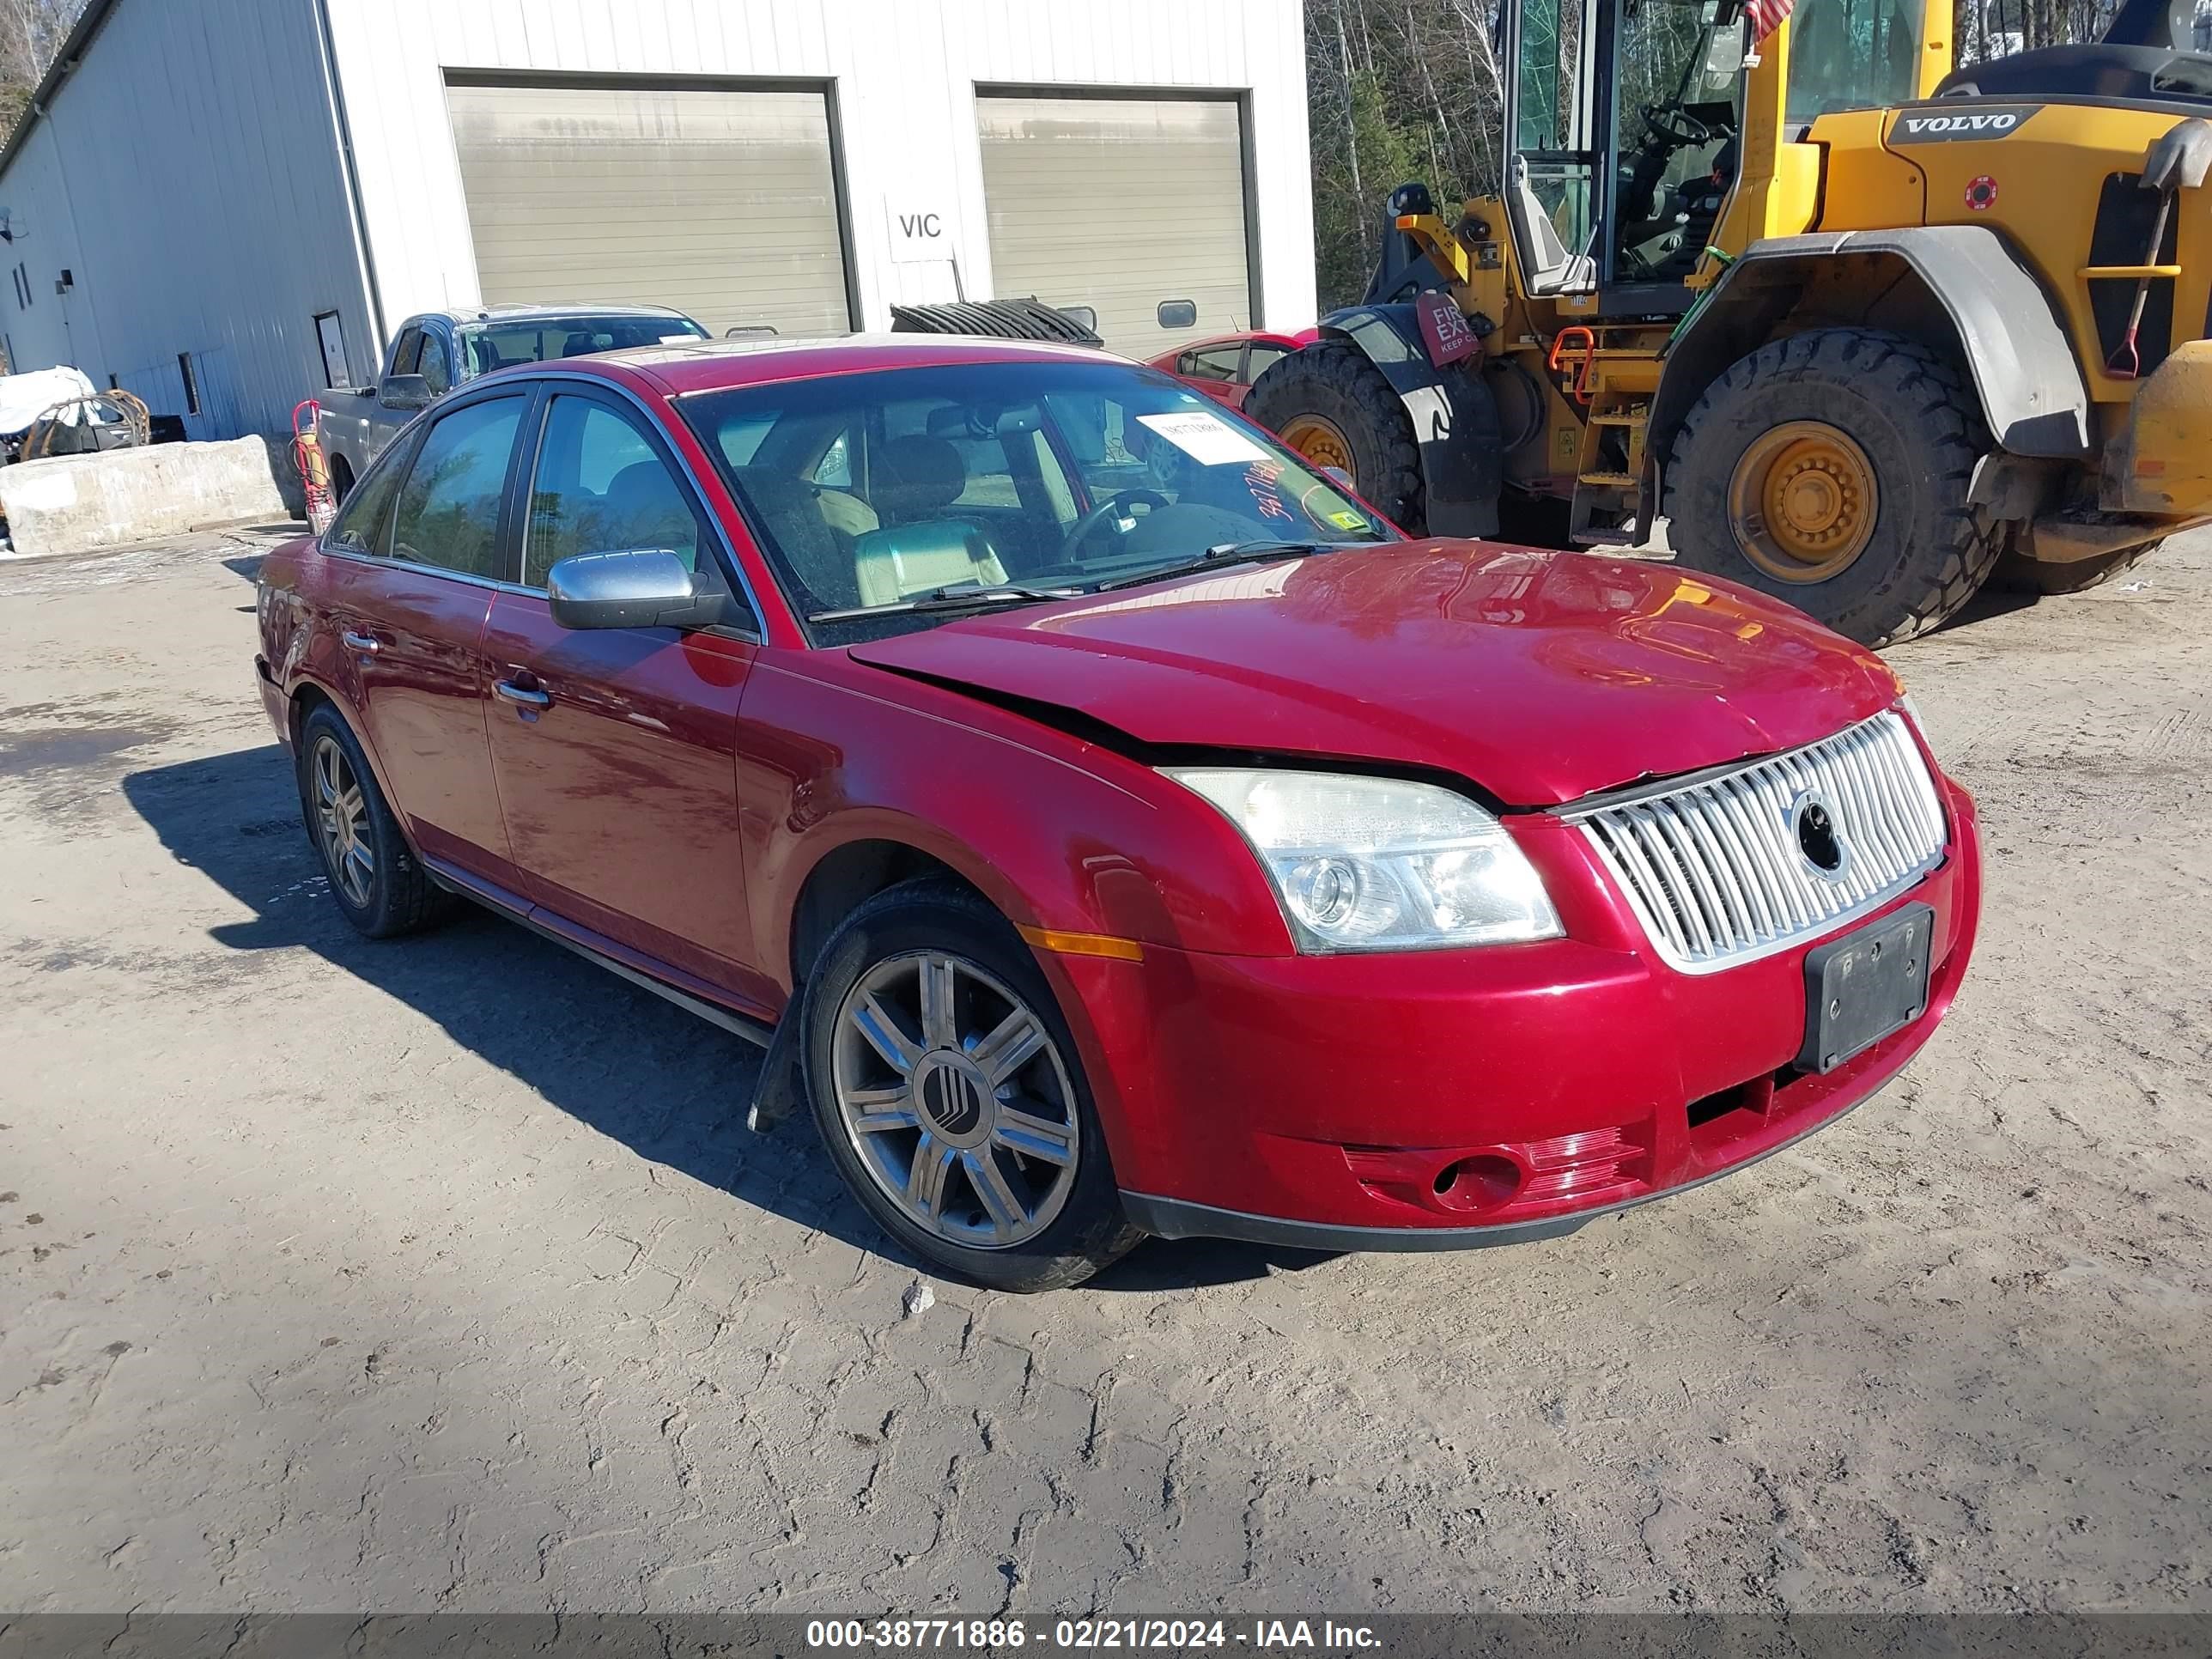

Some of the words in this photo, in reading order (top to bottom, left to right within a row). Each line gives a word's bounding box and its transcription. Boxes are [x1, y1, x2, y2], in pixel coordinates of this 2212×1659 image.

[1906, 114, 2016, 133] VOLVO
[899, 213, 941, 238] VIC
[1432, 306, 1463, 325] FIR
[1441, 337, 1463, 353] KEEP
